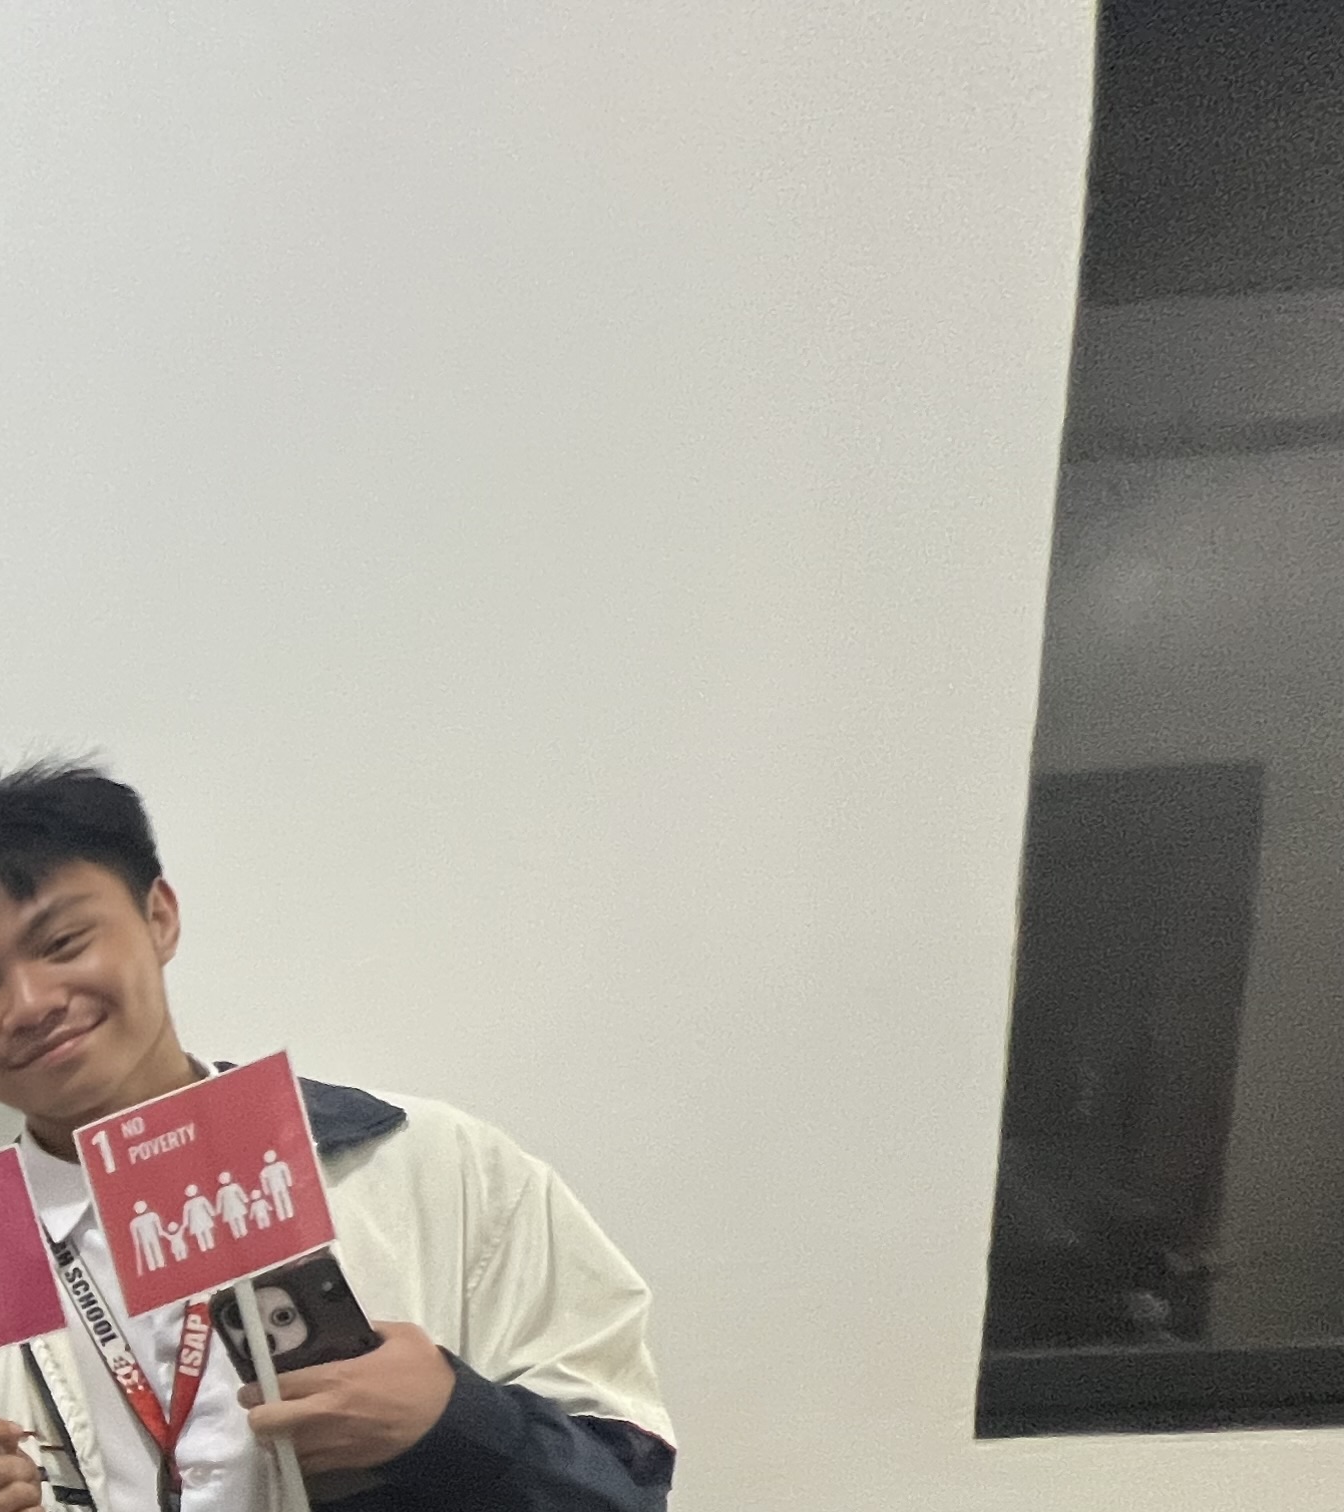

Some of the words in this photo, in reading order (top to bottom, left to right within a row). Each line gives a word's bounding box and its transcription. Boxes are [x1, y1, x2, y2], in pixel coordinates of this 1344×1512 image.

[90, 1130, 117, 1173] 1
[121, 1117, 146, 1138] NO
[128, 1123, 196, 1164] POVERTY
[65, 1267, 117, 1347] SCHOOL
[179, 1314, 211, 1377] ISAP
